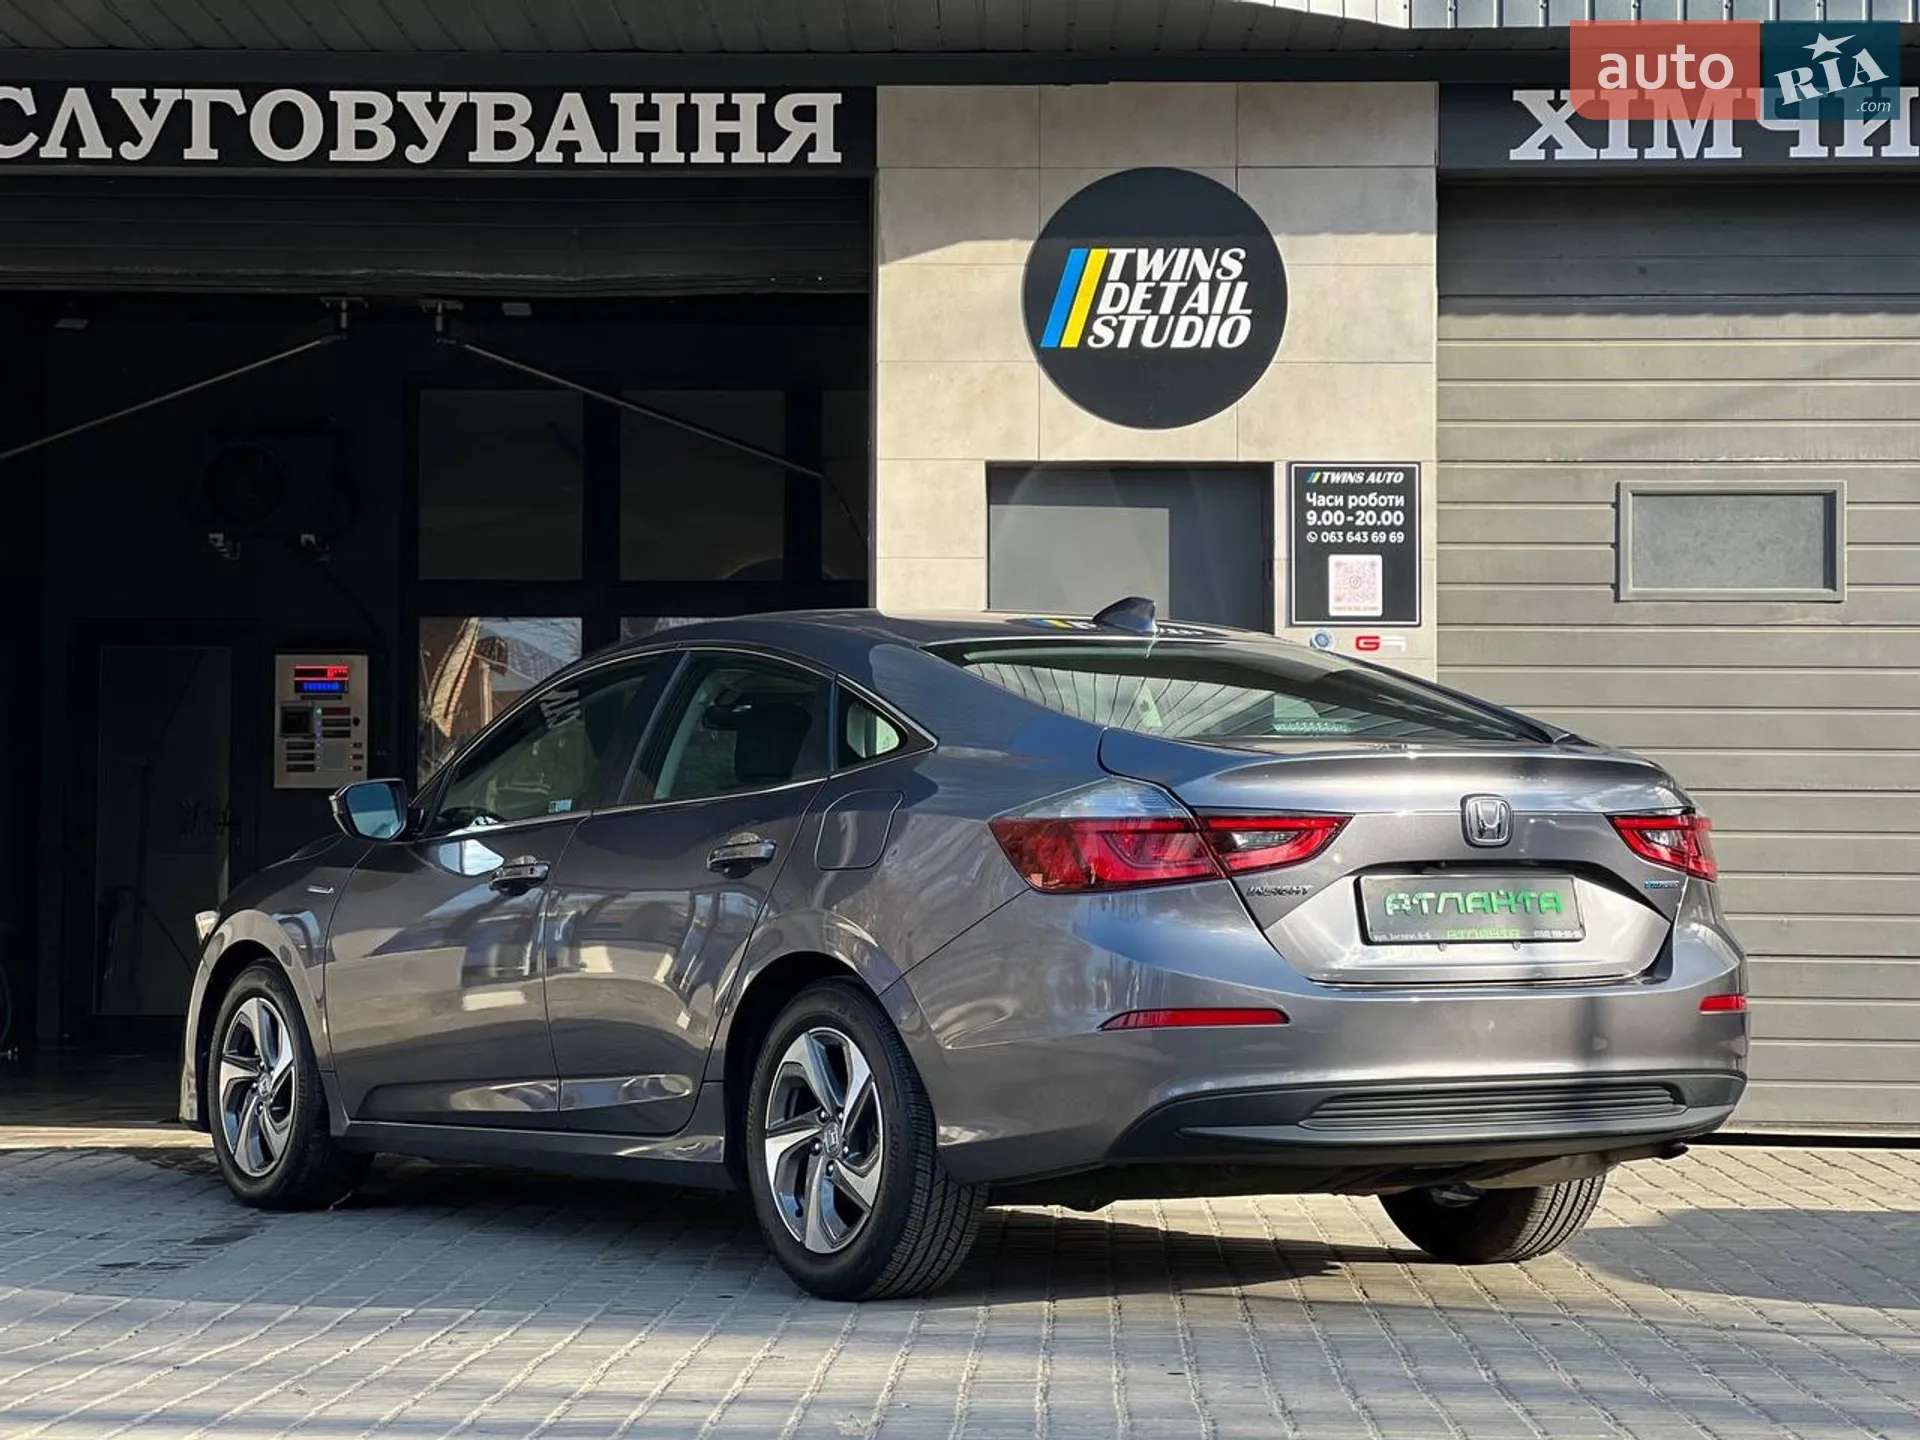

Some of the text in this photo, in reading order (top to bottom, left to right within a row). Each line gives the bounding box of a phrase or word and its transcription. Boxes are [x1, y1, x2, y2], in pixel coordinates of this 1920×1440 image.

[1107, 247, 1247, 281] TWINS
[1097, 282, 1252, 315] DETAIL
[1087, 315, 1252, 349] STUDIO
[1321, 472, 1405, 484] TWINS AUTO
[1306, 492, 1405, 509] Часи роботи
[1321, 531, 1405, 543] 063 643 69 69
